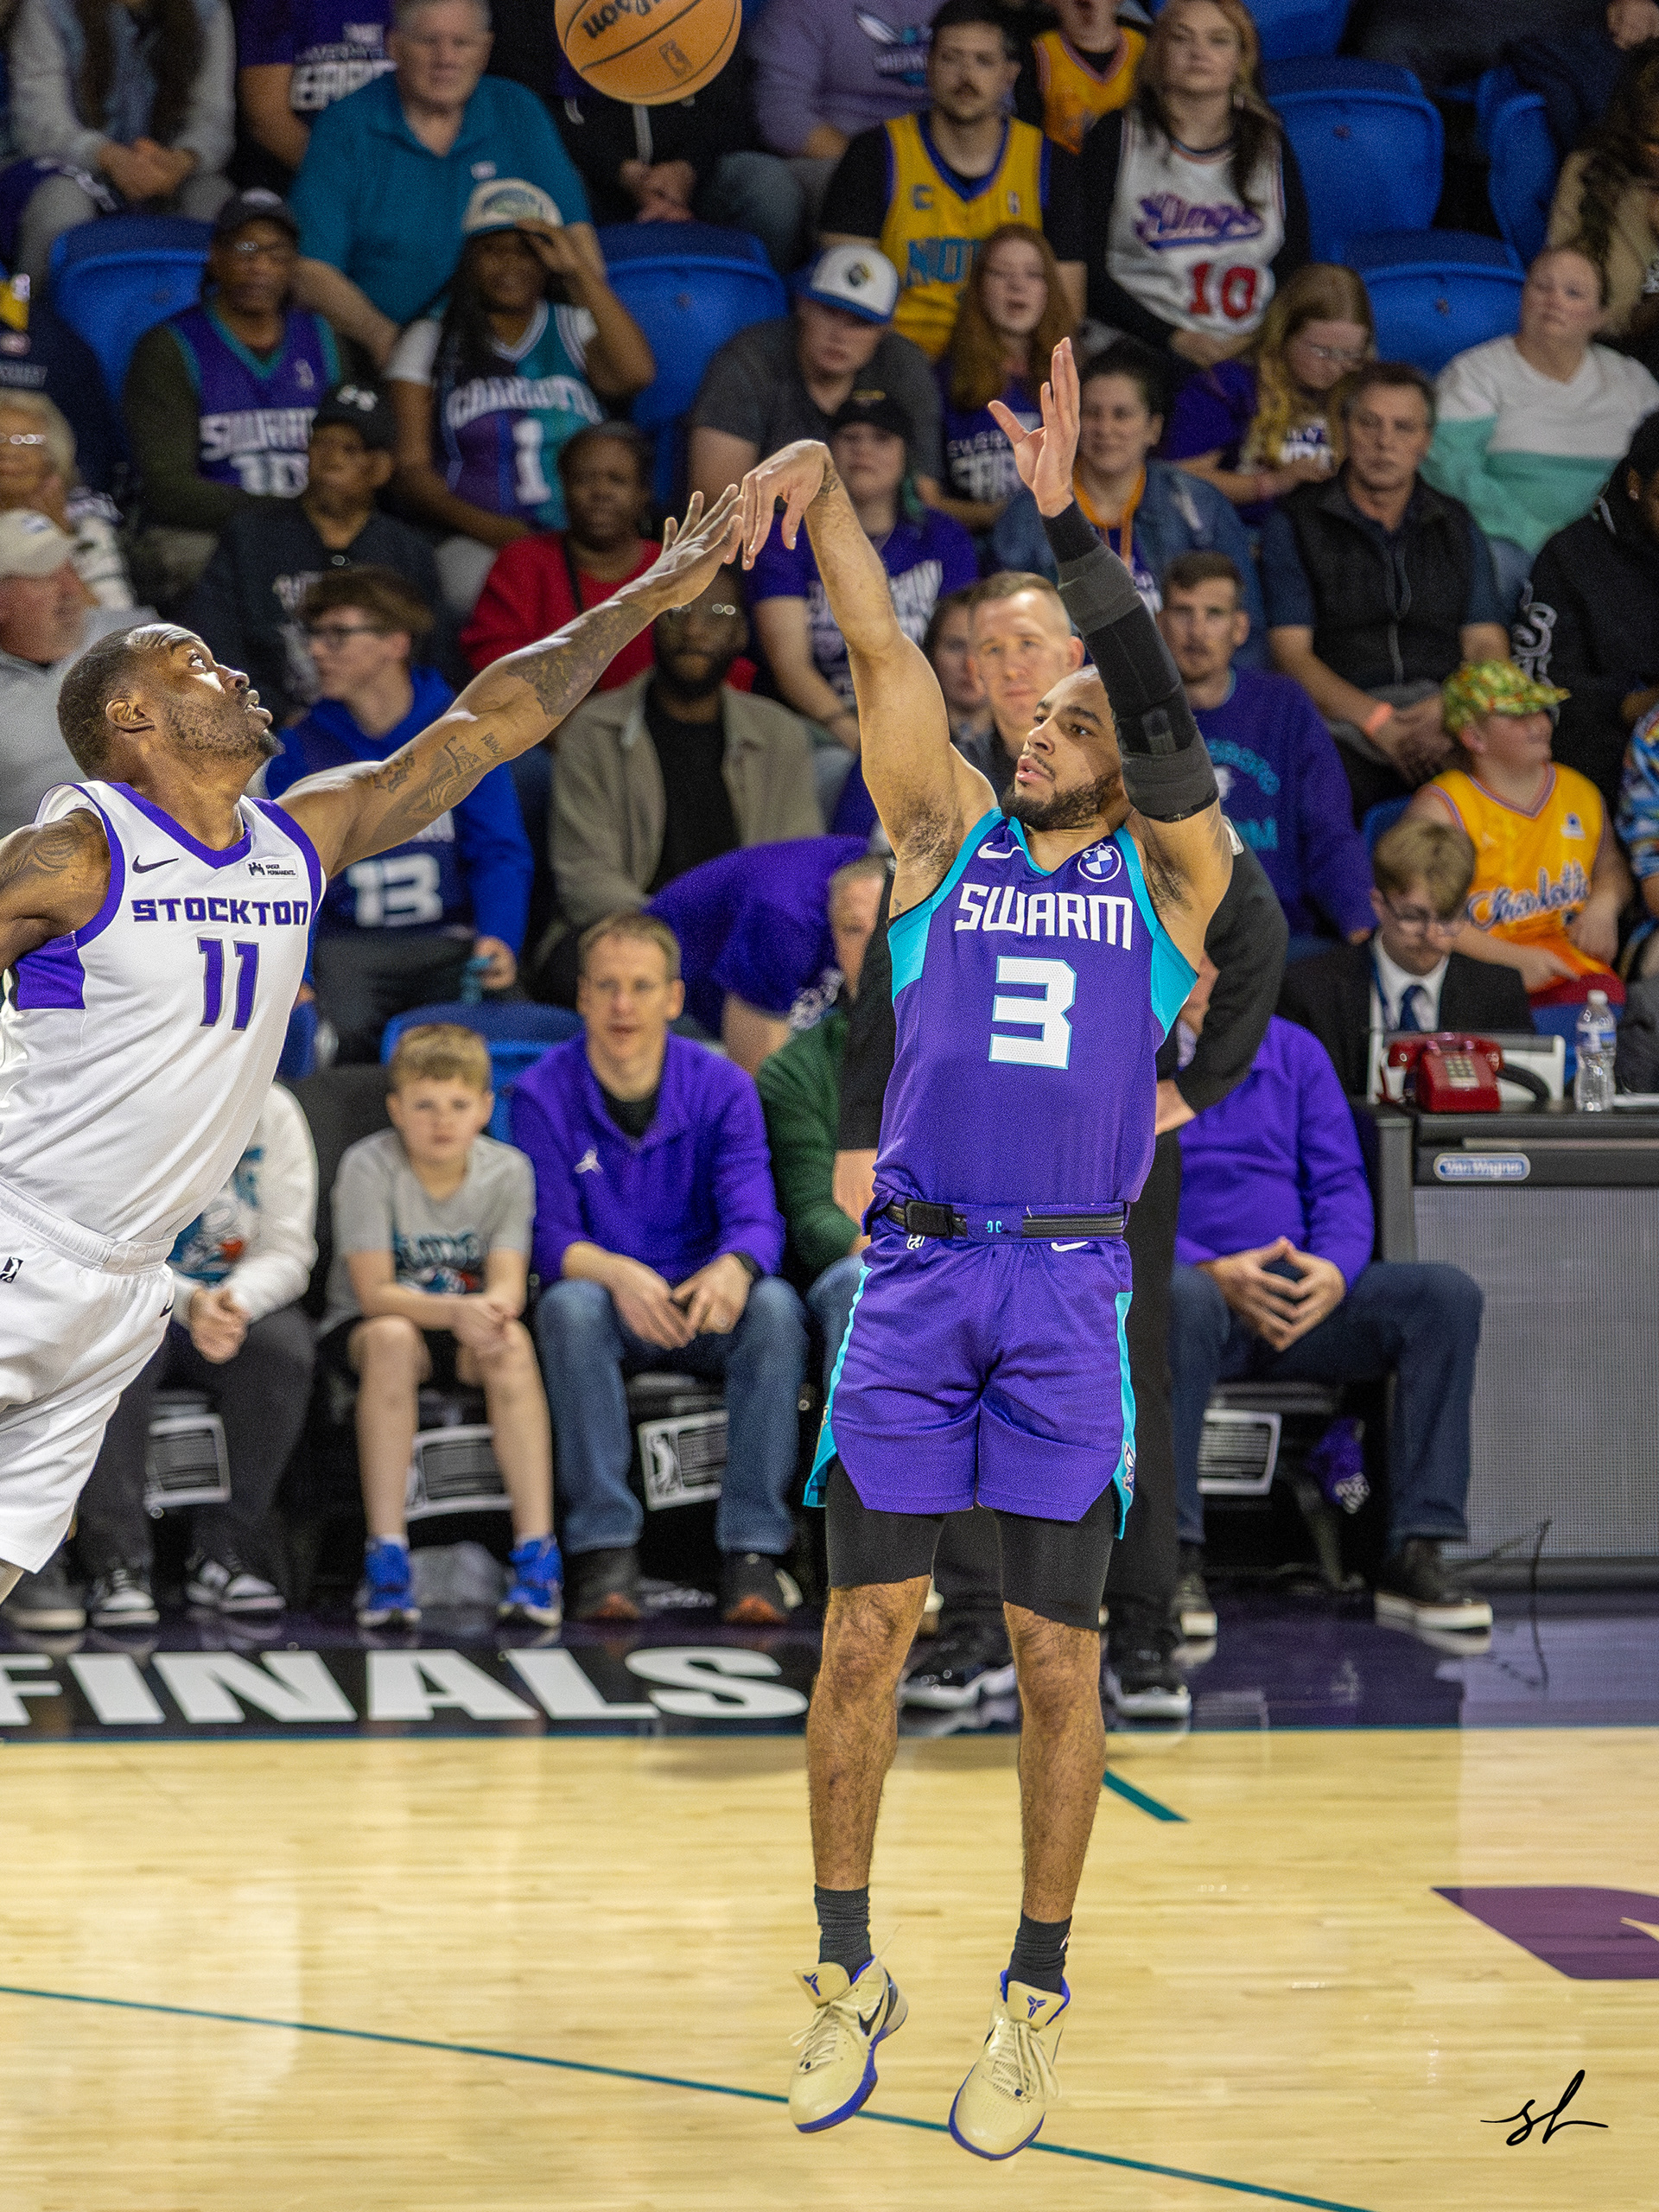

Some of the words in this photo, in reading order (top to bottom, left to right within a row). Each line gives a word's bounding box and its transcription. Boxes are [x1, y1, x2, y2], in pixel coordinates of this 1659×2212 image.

[1187, 262, 1257, 320] 10
[512, 417, 553, 505] 1
[130, 896, 309, 926] STOCKTON
[347, 852, 443, 928] 13
[955, 882, 1134, 951] SWARM
[197, 936, 260, 1032] 11
[988, 955, 1077, 1071] 3
[0, 1646, 810, 1726] FINALS
